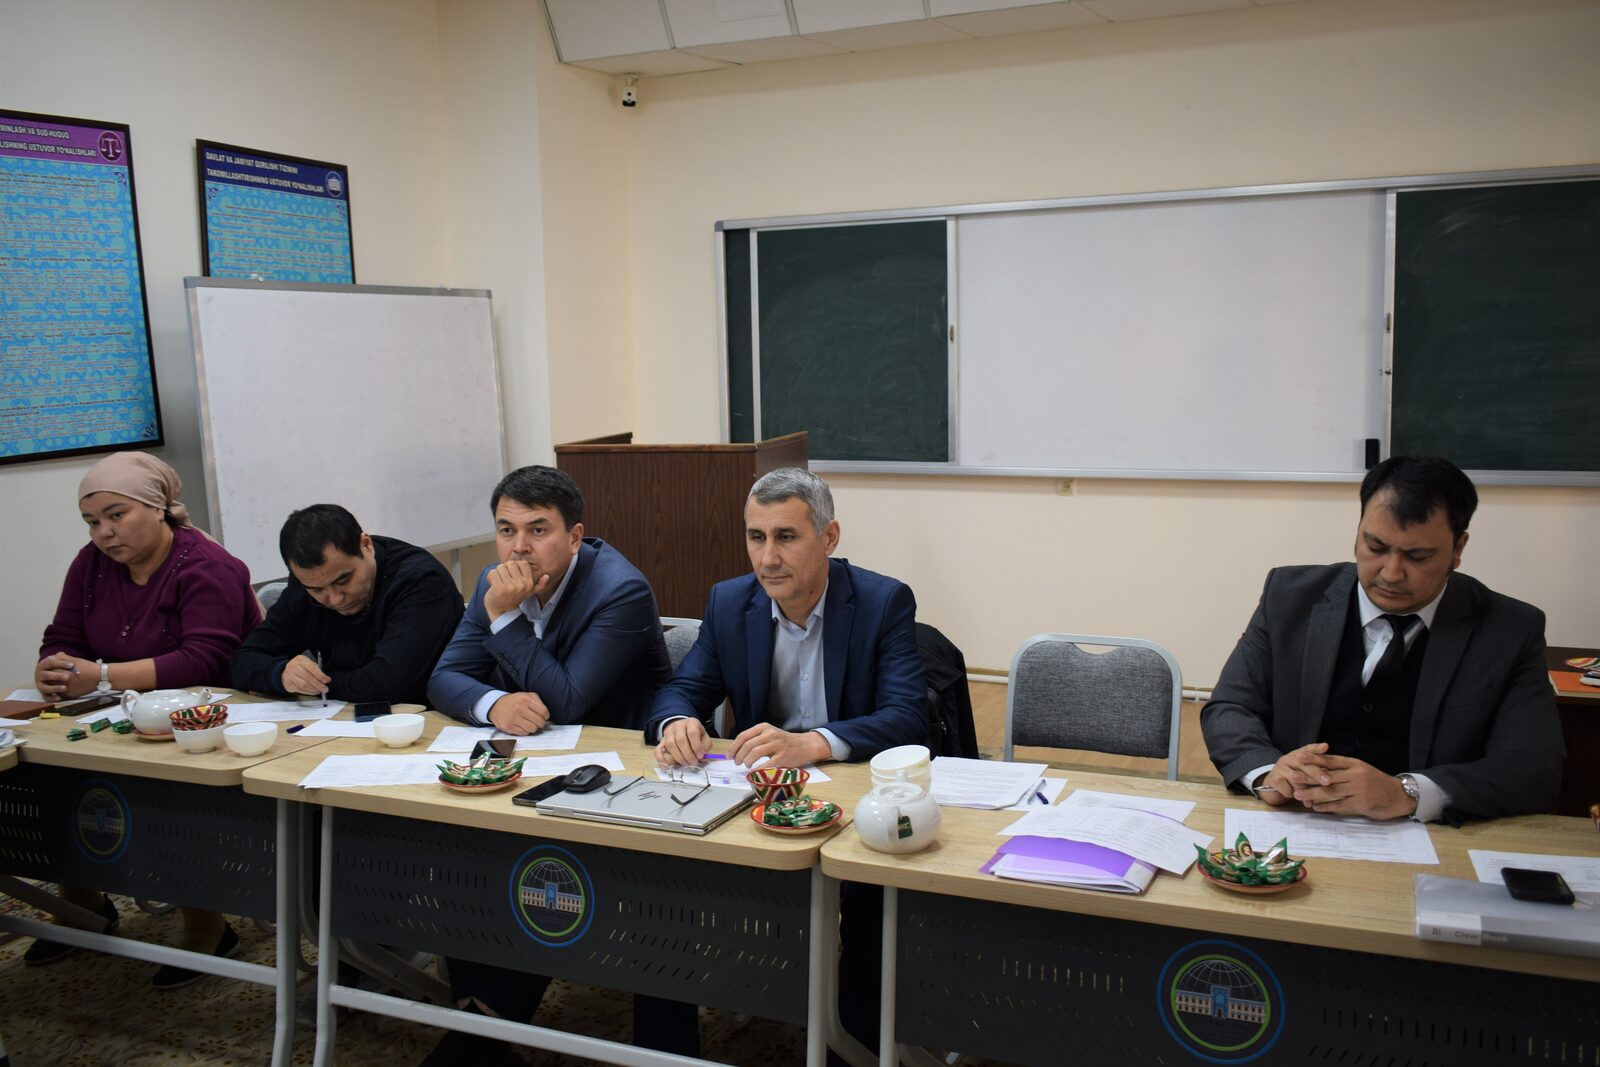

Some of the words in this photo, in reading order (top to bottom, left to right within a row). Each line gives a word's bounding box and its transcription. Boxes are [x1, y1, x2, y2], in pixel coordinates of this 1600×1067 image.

[28, 127, 36, 135] VA
[28, 143, 56, 153] USTUVOR
[206, 151, 225, 162] DAVLAT
[226, 155, 233, 164] VA
[1454, 931, 1480, 940] Clear
